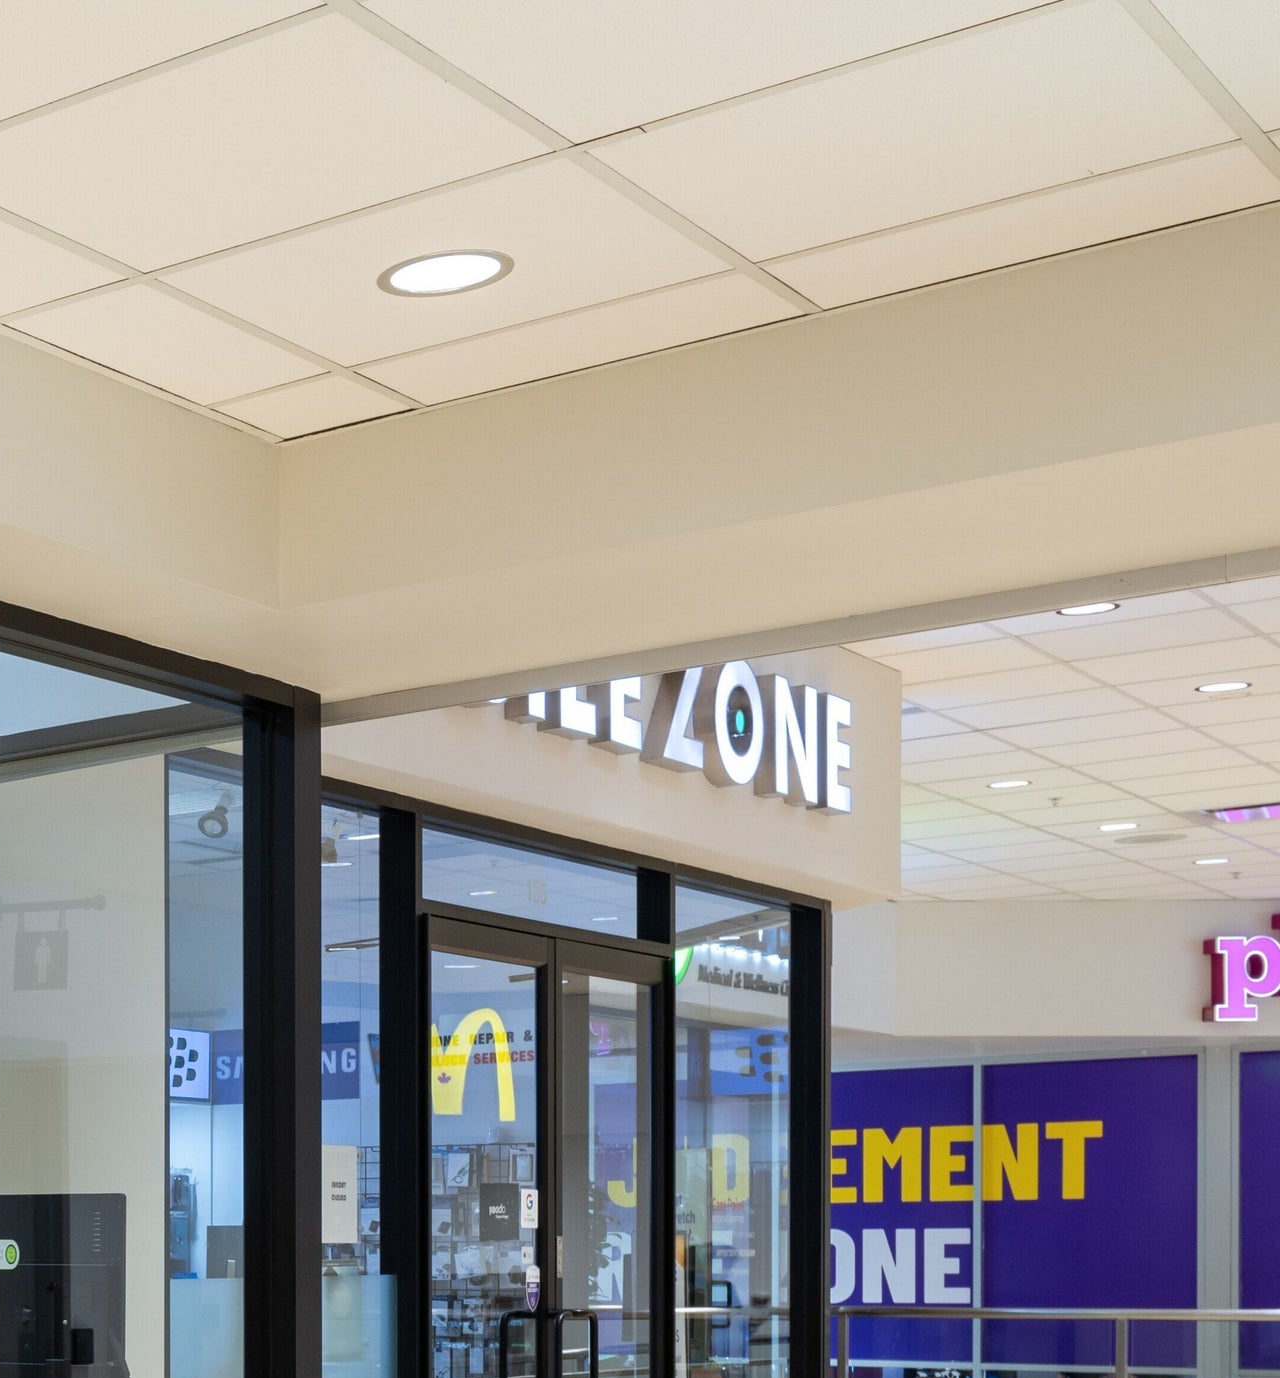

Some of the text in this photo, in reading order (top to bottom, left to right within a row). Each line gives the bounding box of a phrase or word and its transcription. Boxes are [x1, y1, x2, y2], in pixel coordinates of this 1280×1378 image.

[469, 1031, 515, 1045] REPAIR
[523, 1030, 533, 1042] &
[473, 1050, 535, 1065] SERVICES
